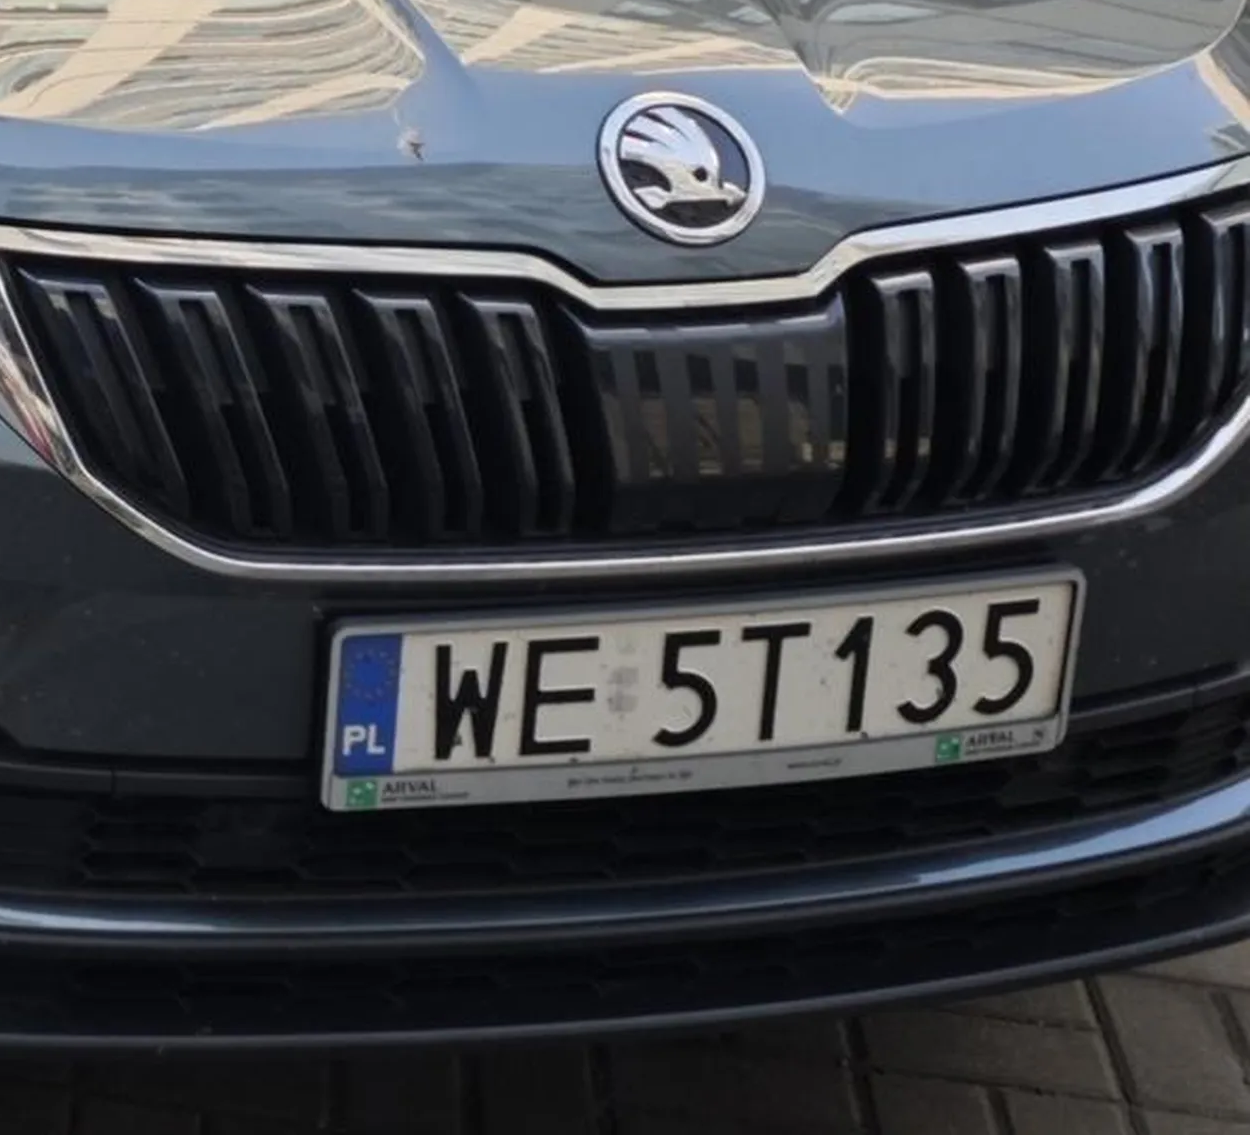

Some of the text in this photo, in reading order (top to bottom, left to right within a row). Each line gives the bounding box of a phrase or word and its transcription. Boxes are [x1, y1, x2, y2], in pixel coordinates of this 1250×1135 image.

[434, 599, 1041, 759] WE 5T135
[342, 724, 386, 756] PL
